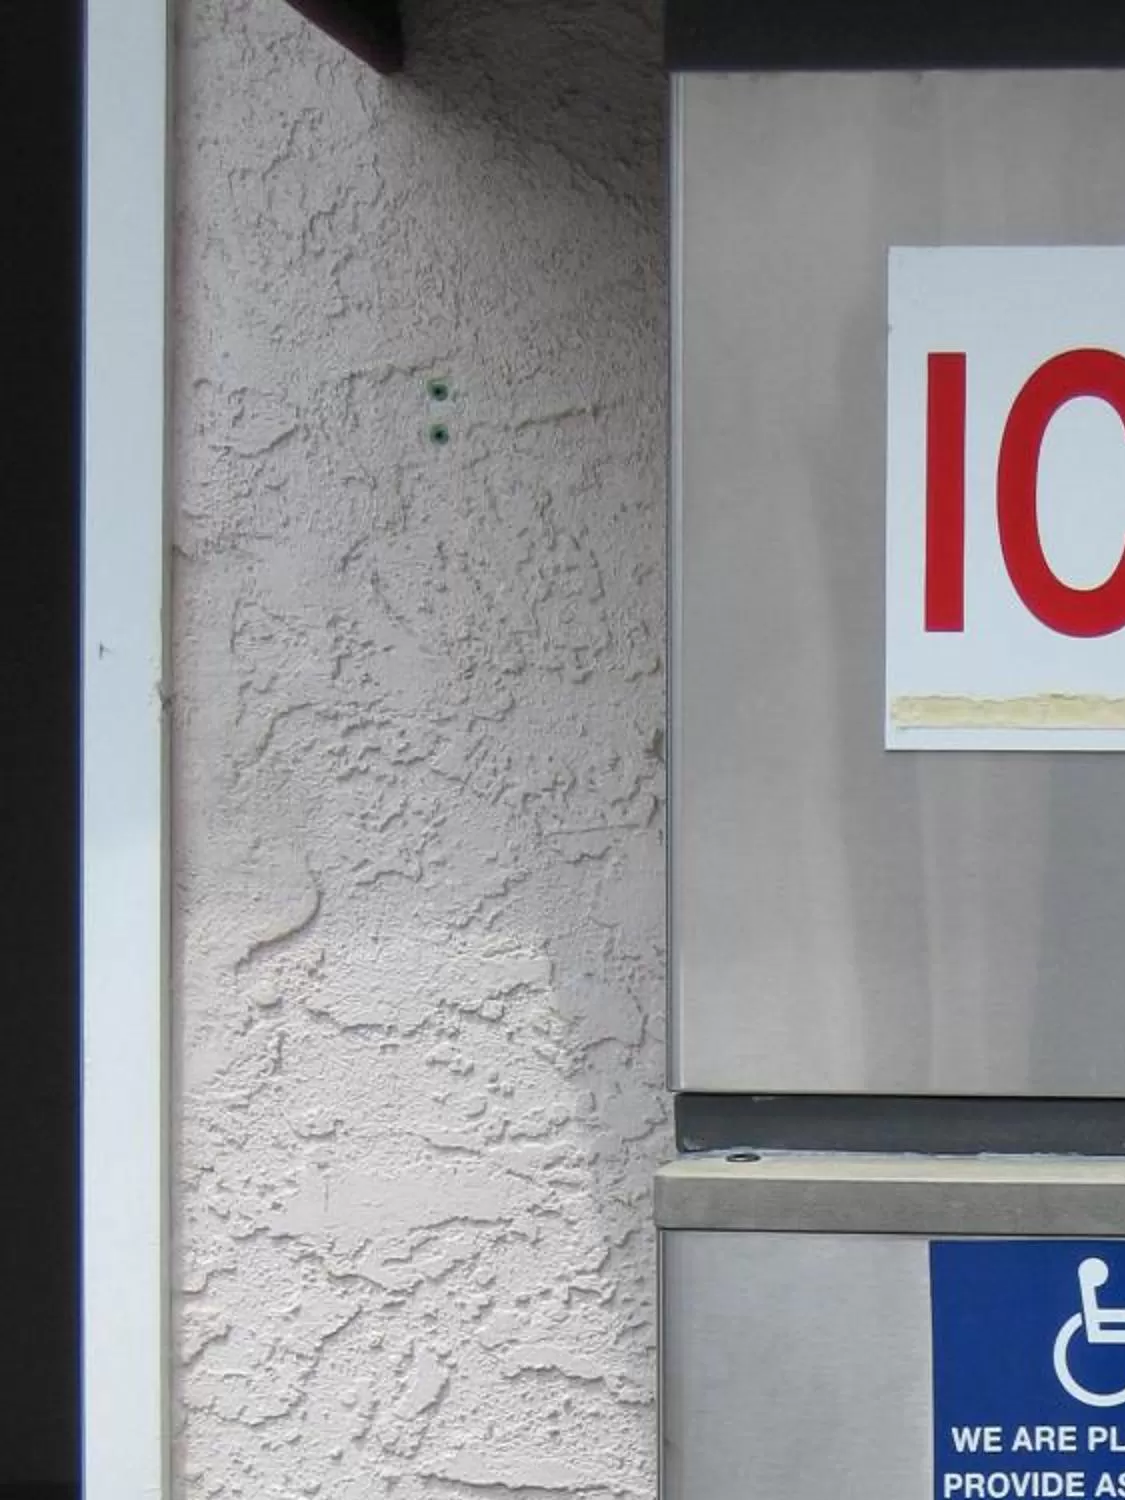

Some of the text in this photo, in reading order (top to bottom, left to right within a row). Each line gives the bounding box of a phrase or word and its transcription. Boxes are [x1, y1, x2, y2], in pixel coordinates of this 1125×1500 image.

[951, 1426, 1003, 1453] WE
[1011, 1425, 1077, 1452] ARE
[943, 1471, 1085, 1499] PROVIDE
